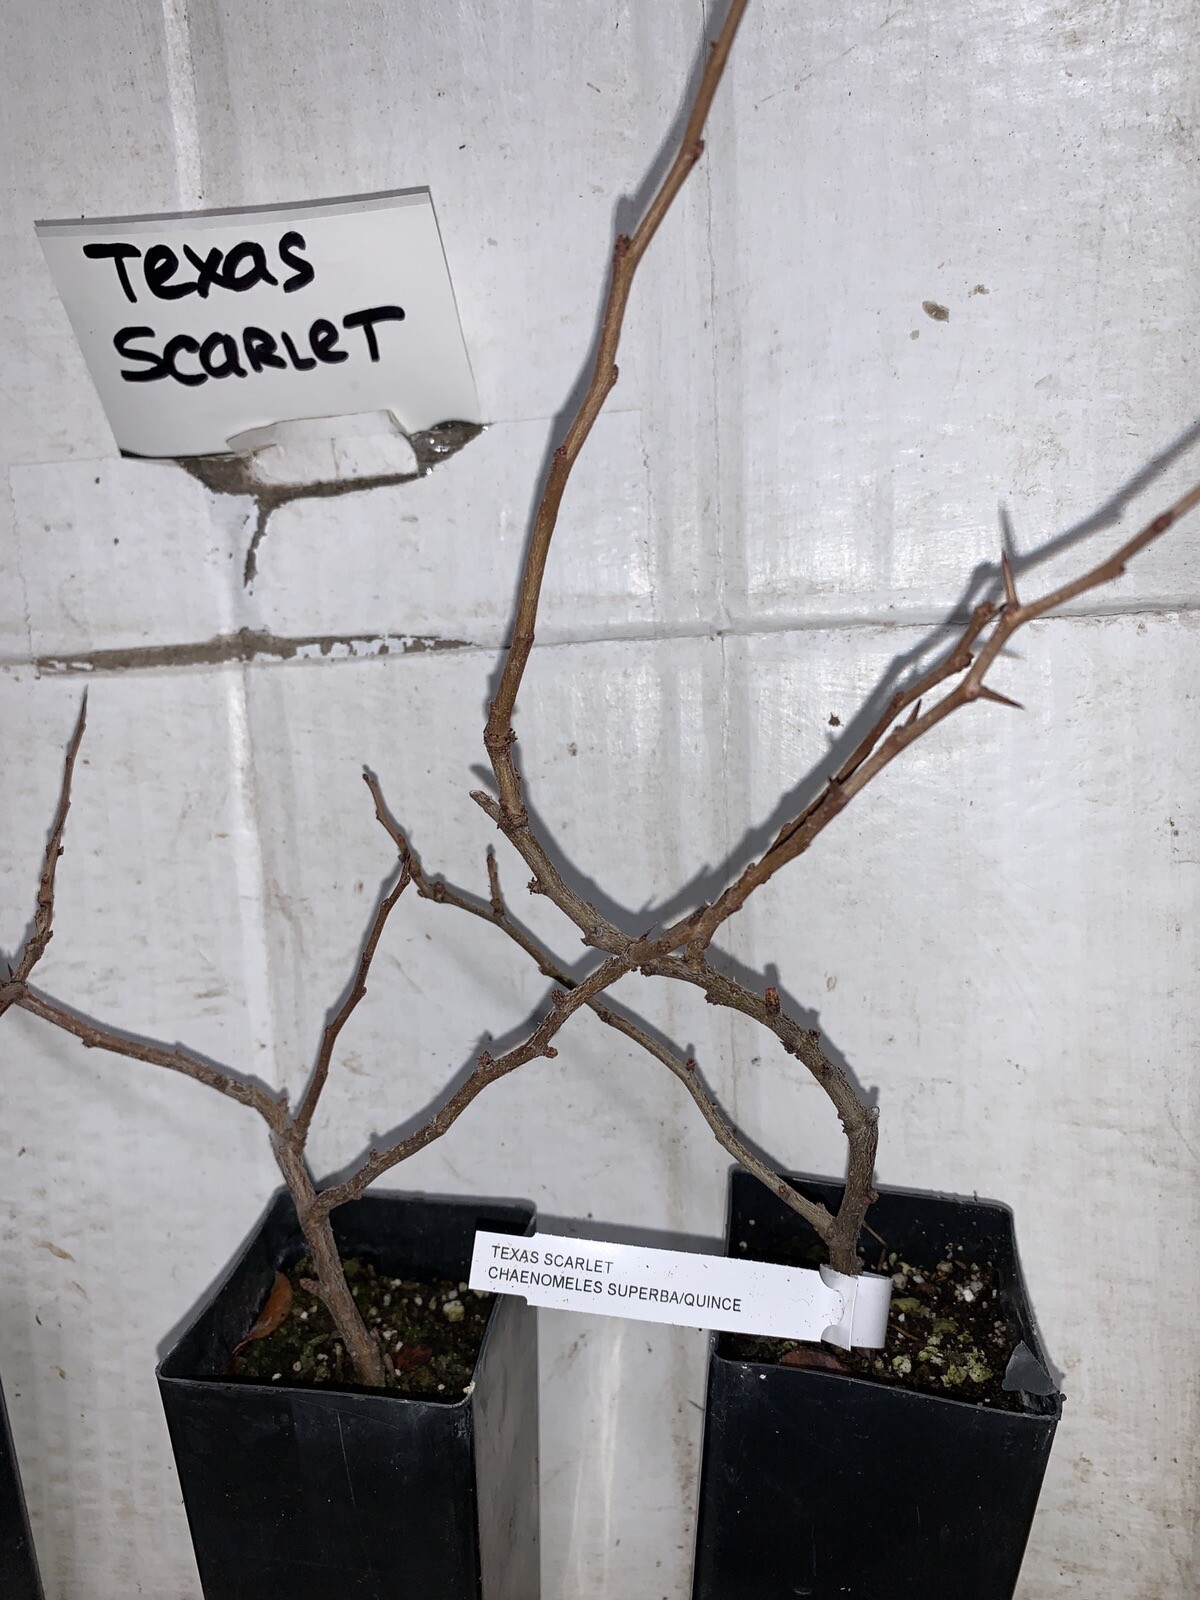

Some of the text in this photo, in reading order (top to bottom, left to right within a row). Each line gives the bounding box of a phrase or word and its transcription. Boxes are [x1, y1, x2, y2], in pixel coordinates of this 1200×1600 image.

[491, 1245, 614, 1274] TEXAS SCARLET
[487, 1266, 742, 1312] CHAENOMELES SUPERBA/QUINCE
